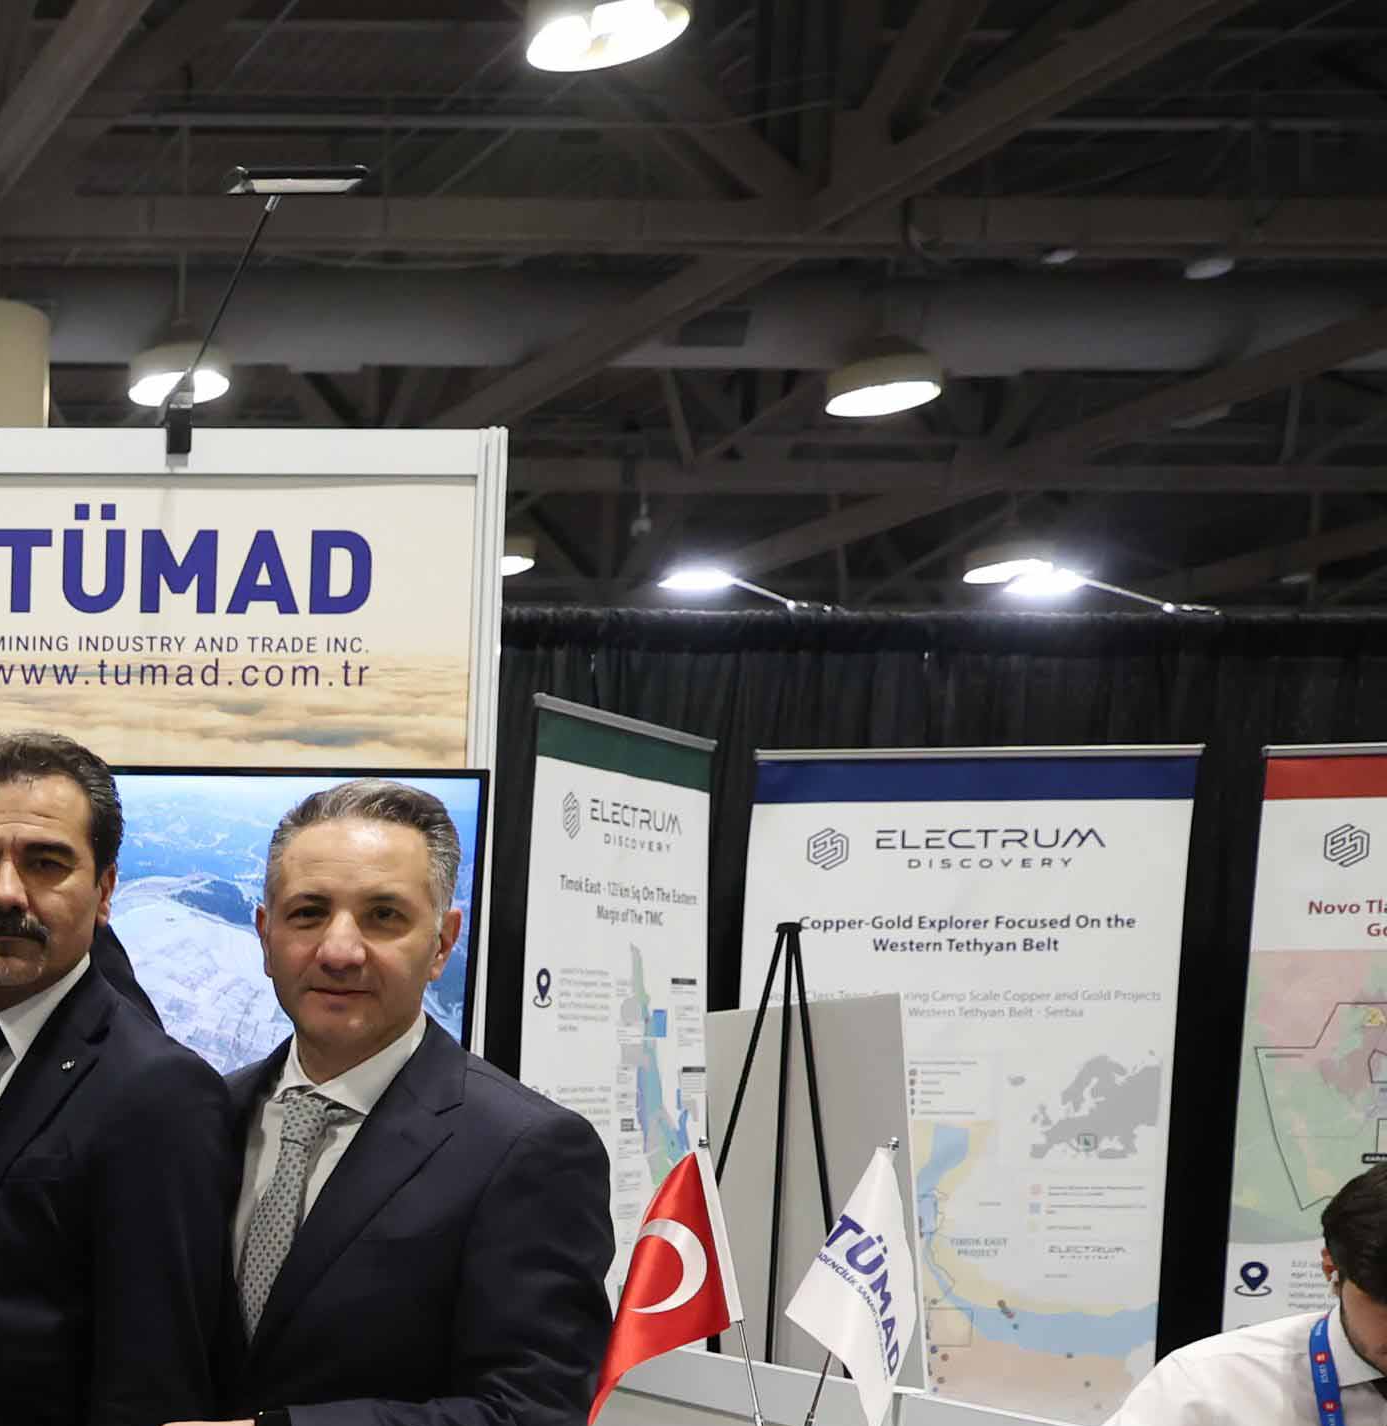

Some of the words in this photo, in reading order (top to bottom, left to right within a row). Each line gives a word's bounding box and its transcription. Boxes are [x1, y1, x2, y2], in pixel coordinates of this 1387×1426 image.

[78, 635, 186, 653] INDUSTRY
[195, 636, 239, 653] AND
[247, 636, 317, 654] TRADE
[326, 637, 370, 654] INC.
[590, 798, 683, 836] ELECTRUM
[603, 833, 671, 854] DISCOVERY
[875, 828, 1107, 850] ELECTRUM
[908, 857, 1074, 870] DISCOVERY
[1308, 900, 1361, 915] Novo
[799, 915, 913, 934] Copper-Gold
[917, 915, 989, 934] Explorer
[995, 914, 1070, 930] Focused
[1075, 914, 1101, 930] On
[1106, 914, 1137, 929] the
[873, 938, 942, 953] Western
[947, 938, 1017, 956] Tethyan
[1022, 937, 1059, 952] Belt
[969, 989, 999, 1002] Scale
[1002, 989, 1051, 1005] Copper
[1055, 989, 1079, 1002] and
[1082, 988, 1112, 1002] Gold
[825, 1213, 900, 1377] TÜMAD
